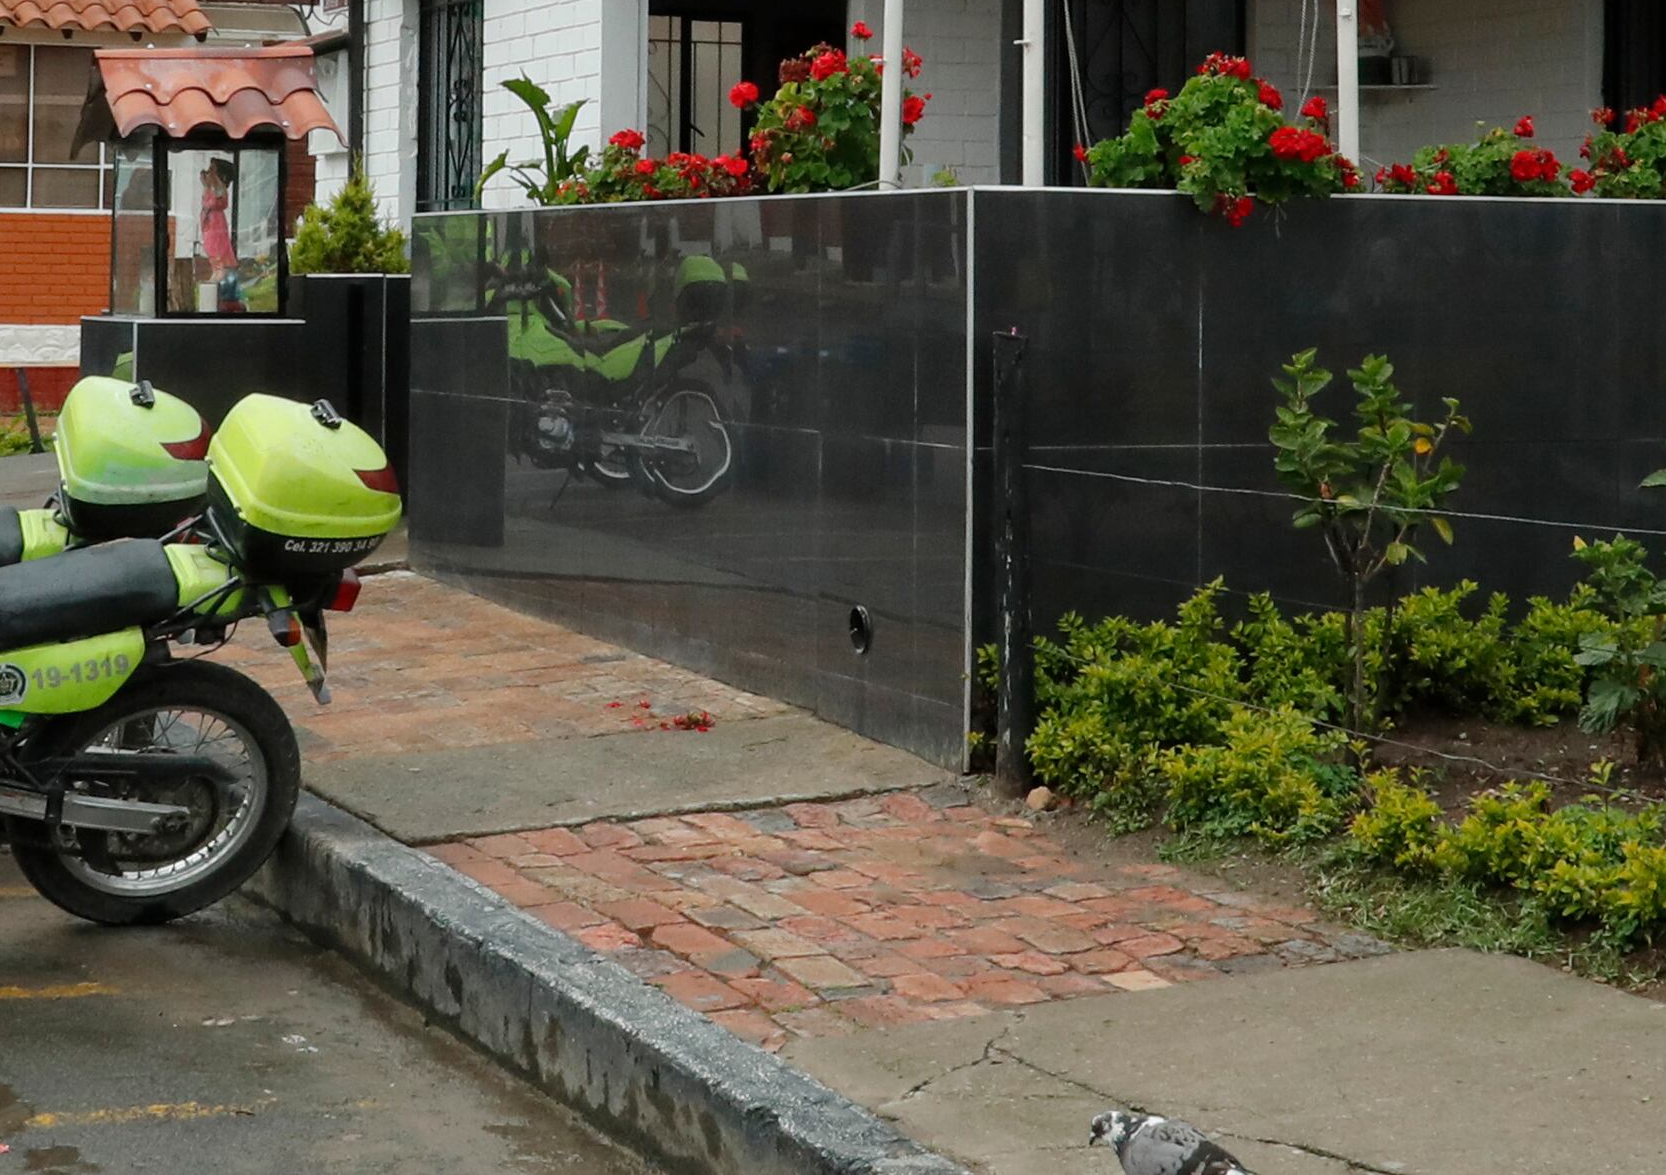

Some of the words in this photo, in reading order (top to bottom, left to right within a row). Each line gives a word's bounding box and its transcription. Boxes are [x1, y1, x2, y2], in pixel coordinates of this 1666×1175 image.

[284, 539, 305, 552] Cel.
[309, 541, 329, 553] 321
[32, 653, 130, 690] 19-1319
